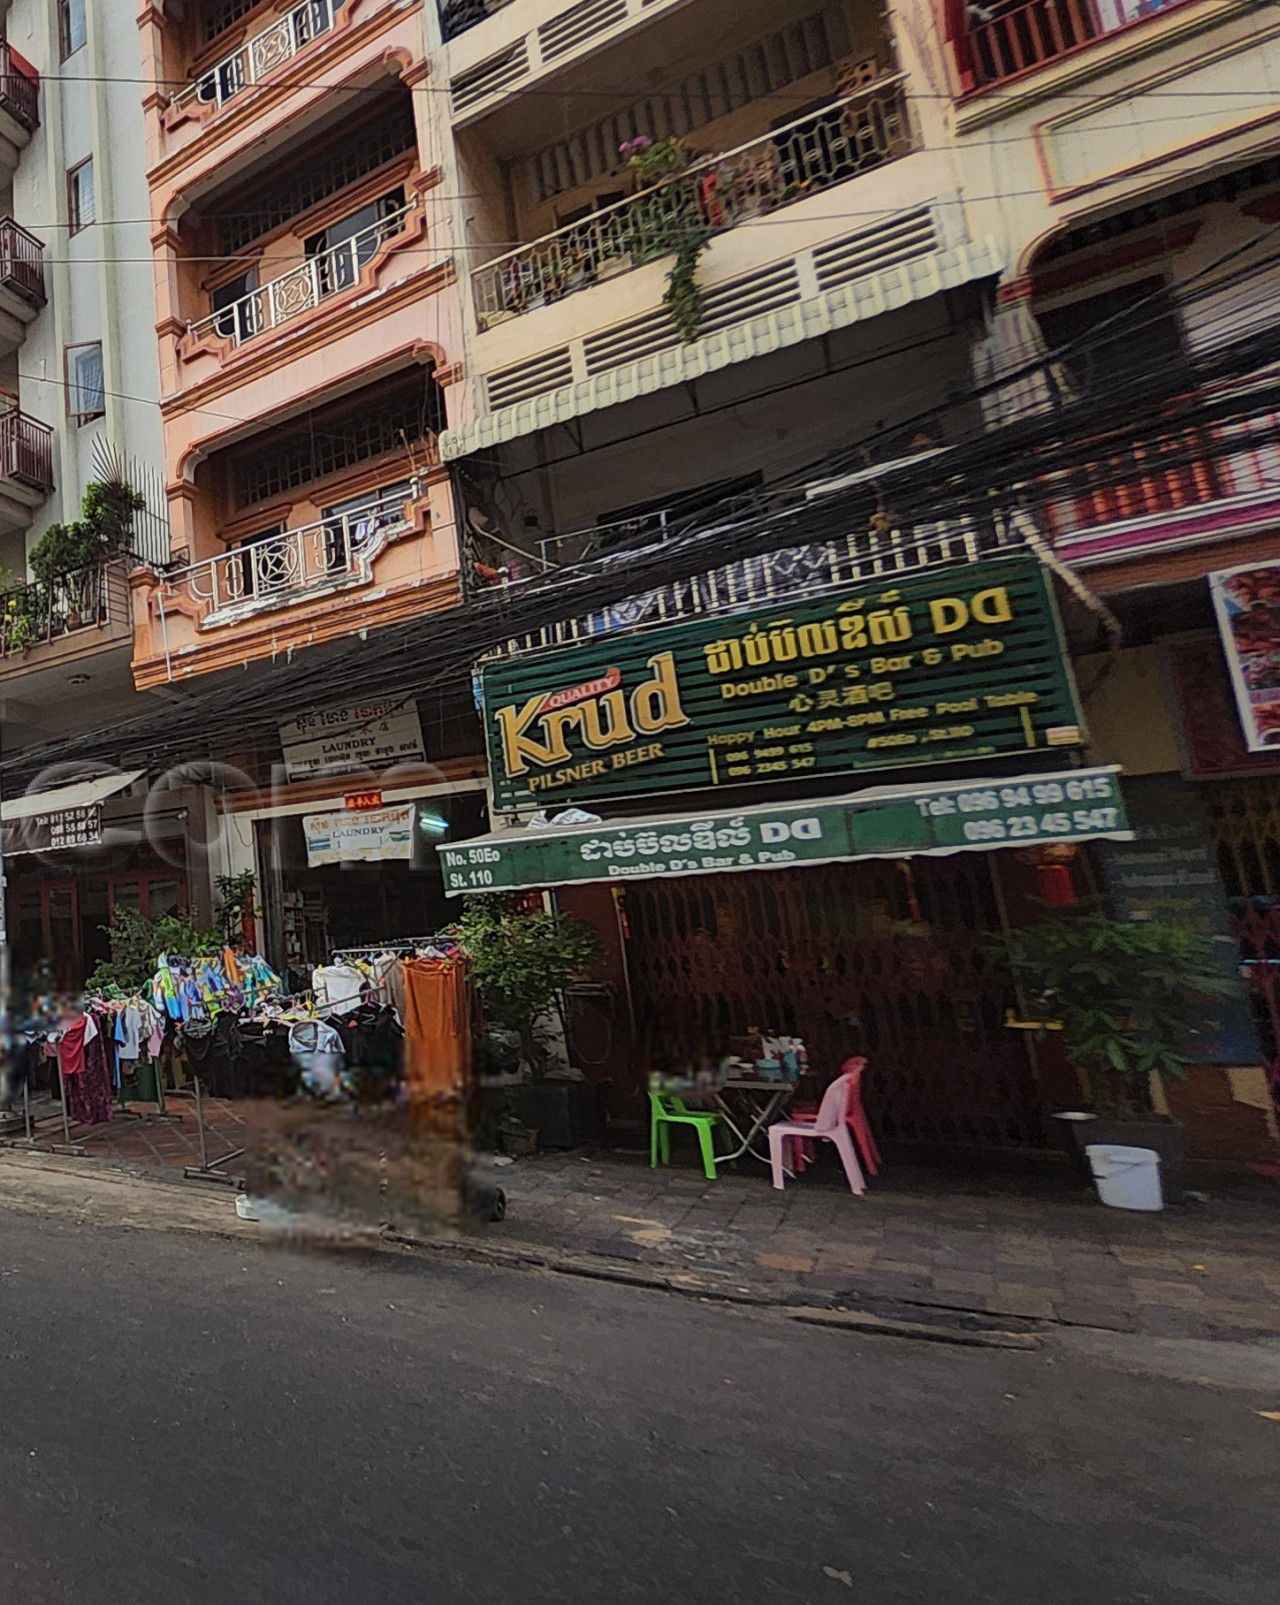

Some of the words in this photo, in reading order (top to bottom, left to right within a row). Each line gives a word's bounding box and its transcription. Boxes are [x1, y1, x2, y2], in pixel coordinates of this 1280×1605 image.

[721, 673, 797, 699] Double
[870, 655, 913, 675] Bar
[922, 647, 942, 666] &
[951, 638, 1004, 662] Pub
[549, 676, 614, 707] QUALITY
[495, 651, 690, 778] Krud
[322, 736, 377, 754] LAUNDRY
[708, 731, 754, 746] Happy
[763, 725, 800, 739] Hour
[526, 760, 608, 792] PILSNER
[612, 743, 665, 769] BEER
[1066, 777, 1112, 801] 615
[332, 826, 386, 838] LAUNDRY
[1006, 815, 1039, 837] 23
[1041, 811, 1071, 833] 45
[1073, 807, 1118, 830] 547
[446, 851, 467, 867] No.
[469, 848, 500, 865] 50Eo
[608, 862, 665, 877] Double
[702, 855, 733, 869] Bar
[738, 853, 754, 865] &
[758, 848, 796, 864] Pub
[449, 871, 467, 887] St.
[469, 869, 493, 886] 110
